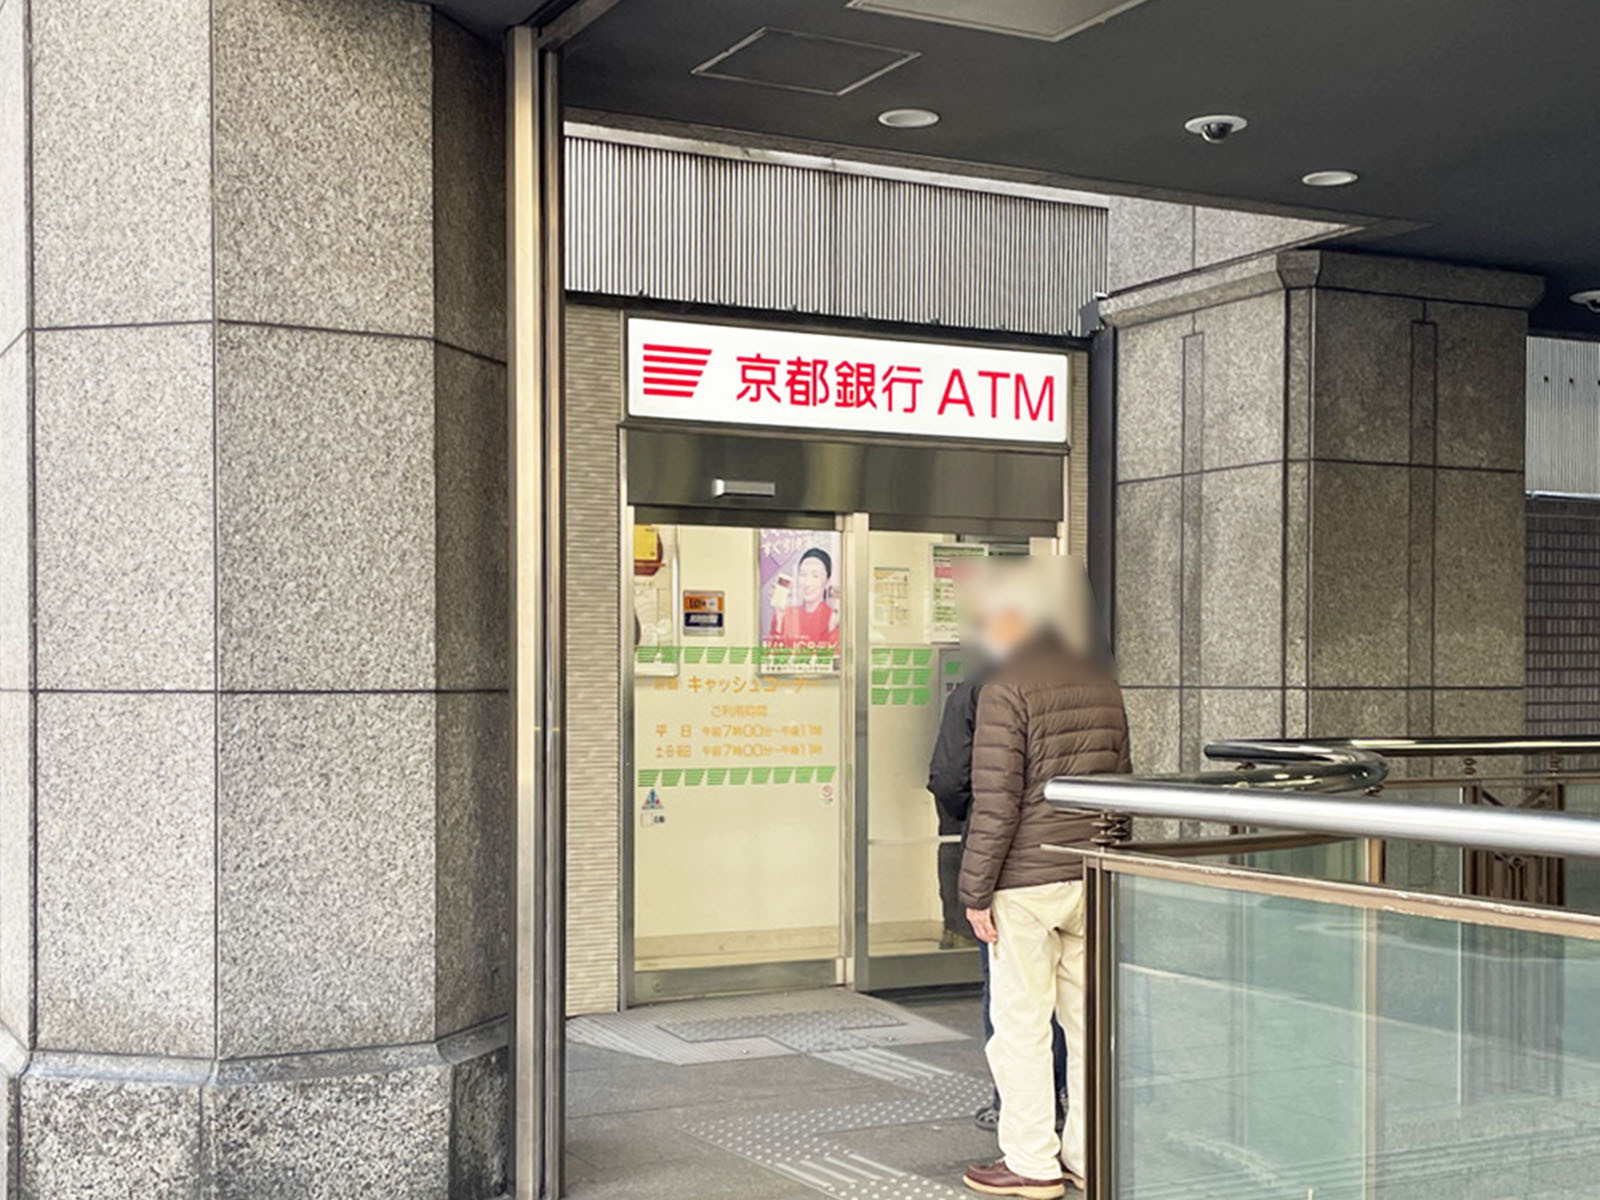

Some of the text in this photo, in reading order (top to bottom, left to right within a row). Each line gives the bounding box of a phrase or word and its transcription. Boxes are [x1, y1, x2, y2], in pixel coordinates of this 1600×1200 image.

[735, 353, 1055, 422] 京都銀行 ATM
